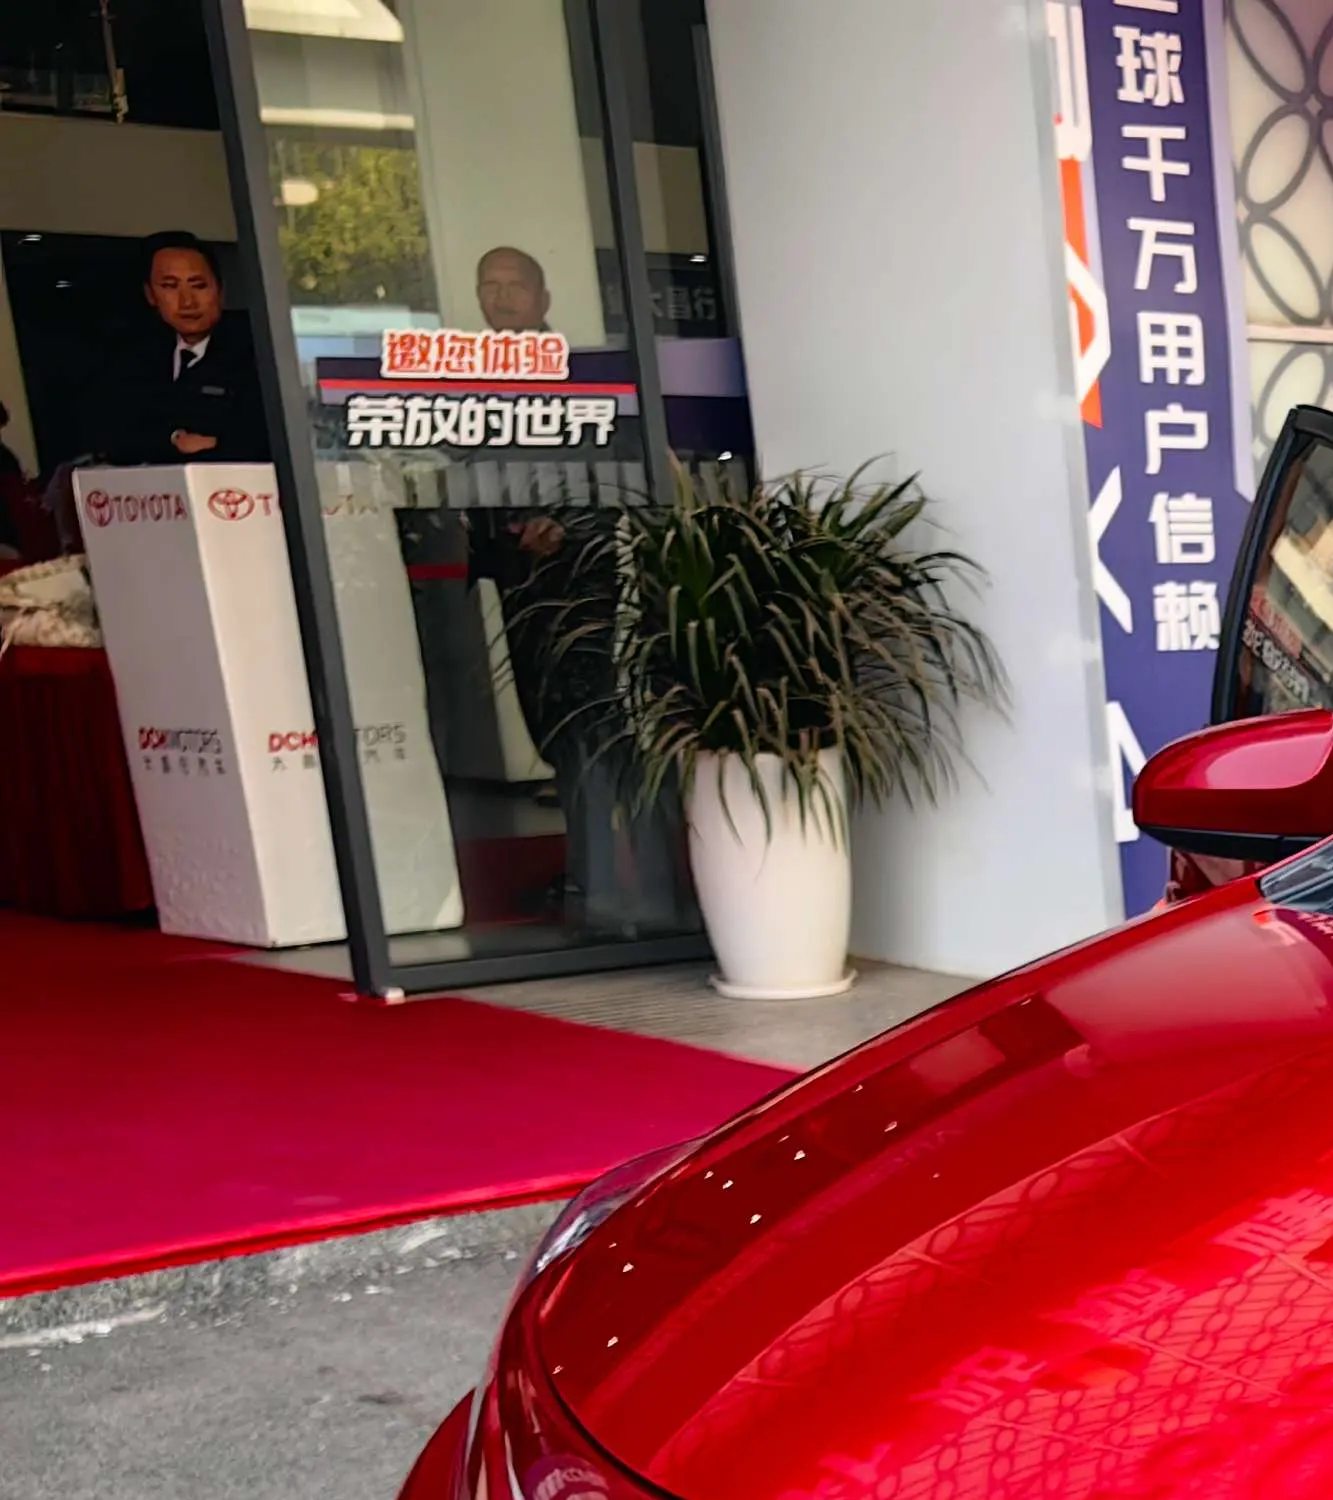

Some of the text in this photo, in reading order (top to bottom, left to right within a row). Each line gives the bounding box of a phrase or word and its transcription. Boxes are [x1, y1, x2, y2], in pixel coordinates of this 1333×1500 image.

[1113, 0, 1222, 652] 球千万用户信赖
[384, 331, 569, 379] 邀您体验
[347, 394, 615, 447] 荣放的世界
